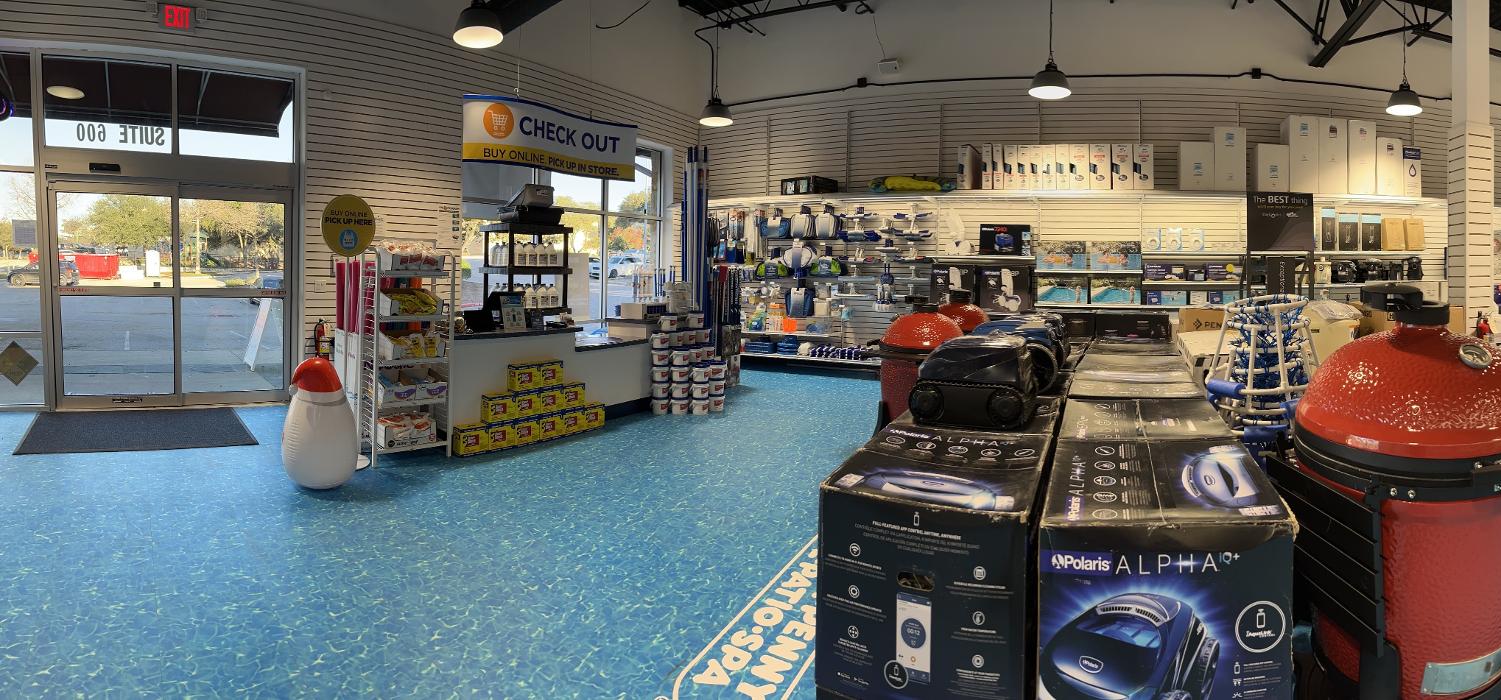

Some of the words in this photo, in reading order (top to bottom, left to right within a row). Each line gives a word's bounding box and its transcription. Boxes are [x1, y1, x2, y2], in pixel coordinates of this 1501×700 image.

[164, 4, 191, 30] EXIT
[519, 116, 577, 147] CHECK
[581, 132, 621, 153] OUT
[483, 147, 506, 158] BUY
[548, 156, 566, 168] PICK
[566, 160, 577, 170] UP
[577, 163, 587, 172] IN
[587, 165, 620, 176] STORE.
[1253, 195, 1266, 203] The
[1267, 195, 1290, 204] BEST
[1290, 196, 1308, 206] thing
[324, 216, 342, 225] PICK
[1204, 321, 1223, 329] PEN
[931, 435, 999, 447] ALPHA
[1068, 461, 1086, 496] ALPHA
[1064, 554, 1110, 572] Polaris
[1115, 553, 1219, 575] ALPHA
